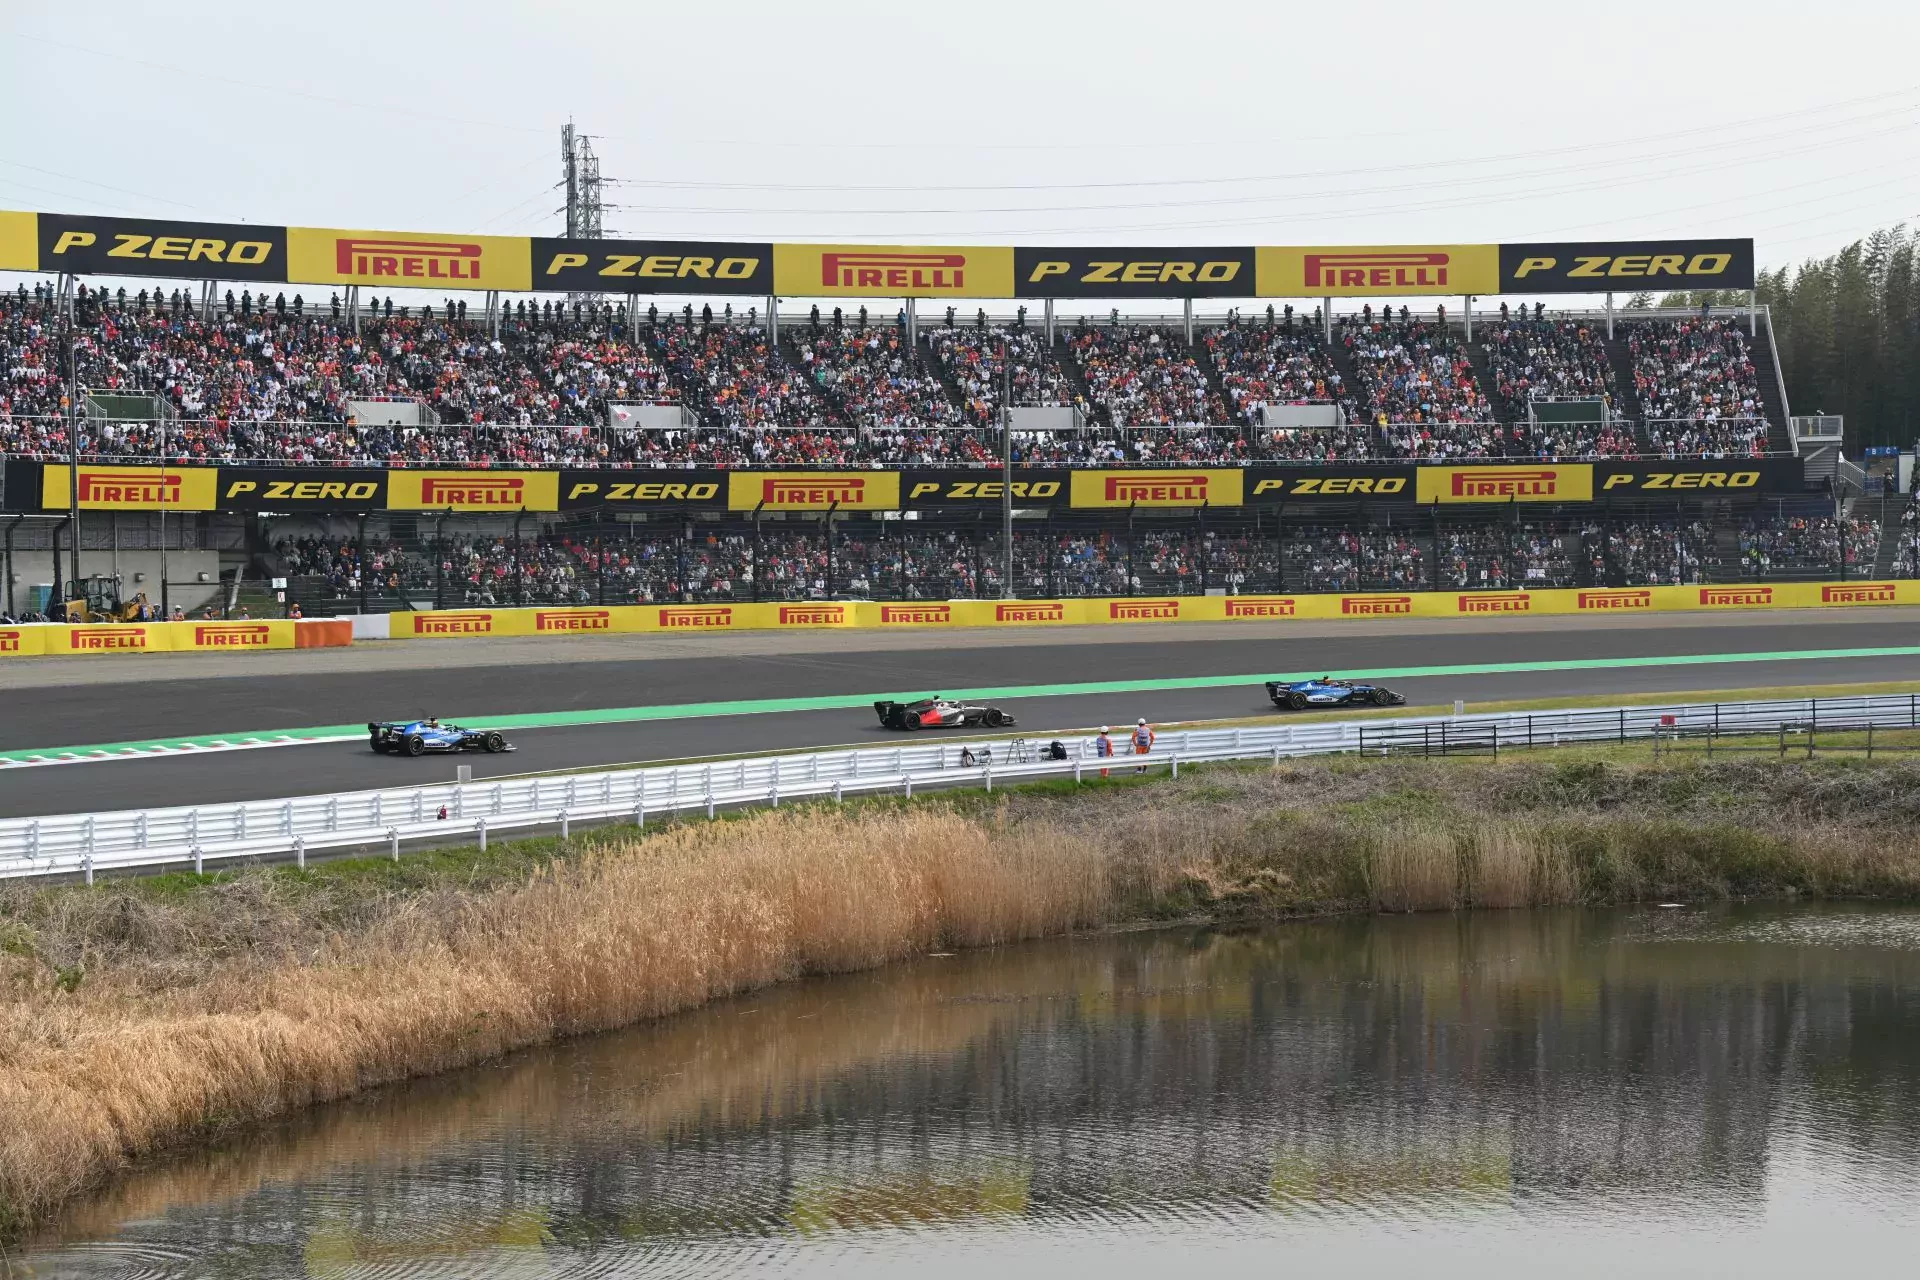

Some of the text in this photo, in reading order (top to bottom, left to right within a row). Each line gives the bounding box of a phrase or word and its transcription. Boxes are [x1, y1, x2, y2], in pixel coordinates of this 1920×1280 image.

[53, 231, 273, 264] P ZERO
[337, 239, 481, 279] PIRELLI
[546, 253, 760, 279] P ZERO
[1515, 254, 1732, 278] P ZERO
[823, 253, 965, 287] PIRELLI
[1029, 261, 1241, 282] P ZERO
[1305, 253, 1448, 287] PIRELLI
[78, 474, 181, 502] PIRELLI
[227, 481, 378, 499] P ZERO
[1105, 477, 1207, 501] PIRELLI
[1253, 478, 1407, 495] P ZERO
[1452, 471, 1557, 496] PIRELLI
[1603, 472, 1761, 490] P ZERO
[422, 478, 524, 504] PIRELLI
[569, 483, 719, 500] P ZERO
[762, 479, 864, 504] PIRELLI
[909, 482, 1061, 499] P ZERO
[1578, 591, 1650, 608] PIRELLI
[1699, 588, 1772, 604] PIRELLI
[1822, 585, 1895, 601] PIRELLI
[1110, 602, 1178, 618] PIRELLI
[1226, 600, 1296, 616] PIRELLI
[1342, 598, 1410, 613] PIRELLI
[1458, 595, 1529, 610] PIRELLI
[536, 612, 609, 630] PIRELLI
[659, 610, 732, 627] PIRELLI
[780, 608, 845, 625] PIRELLI
[881, 607, 951, 623] PIRELLI
[996, 605, 1064, 621] PIRELLI
[414, 614, 492, 633] PIRELLI
[71, 628, 146, 649] PIRELLI
[196, 626, 270, 645] PIRELLI
